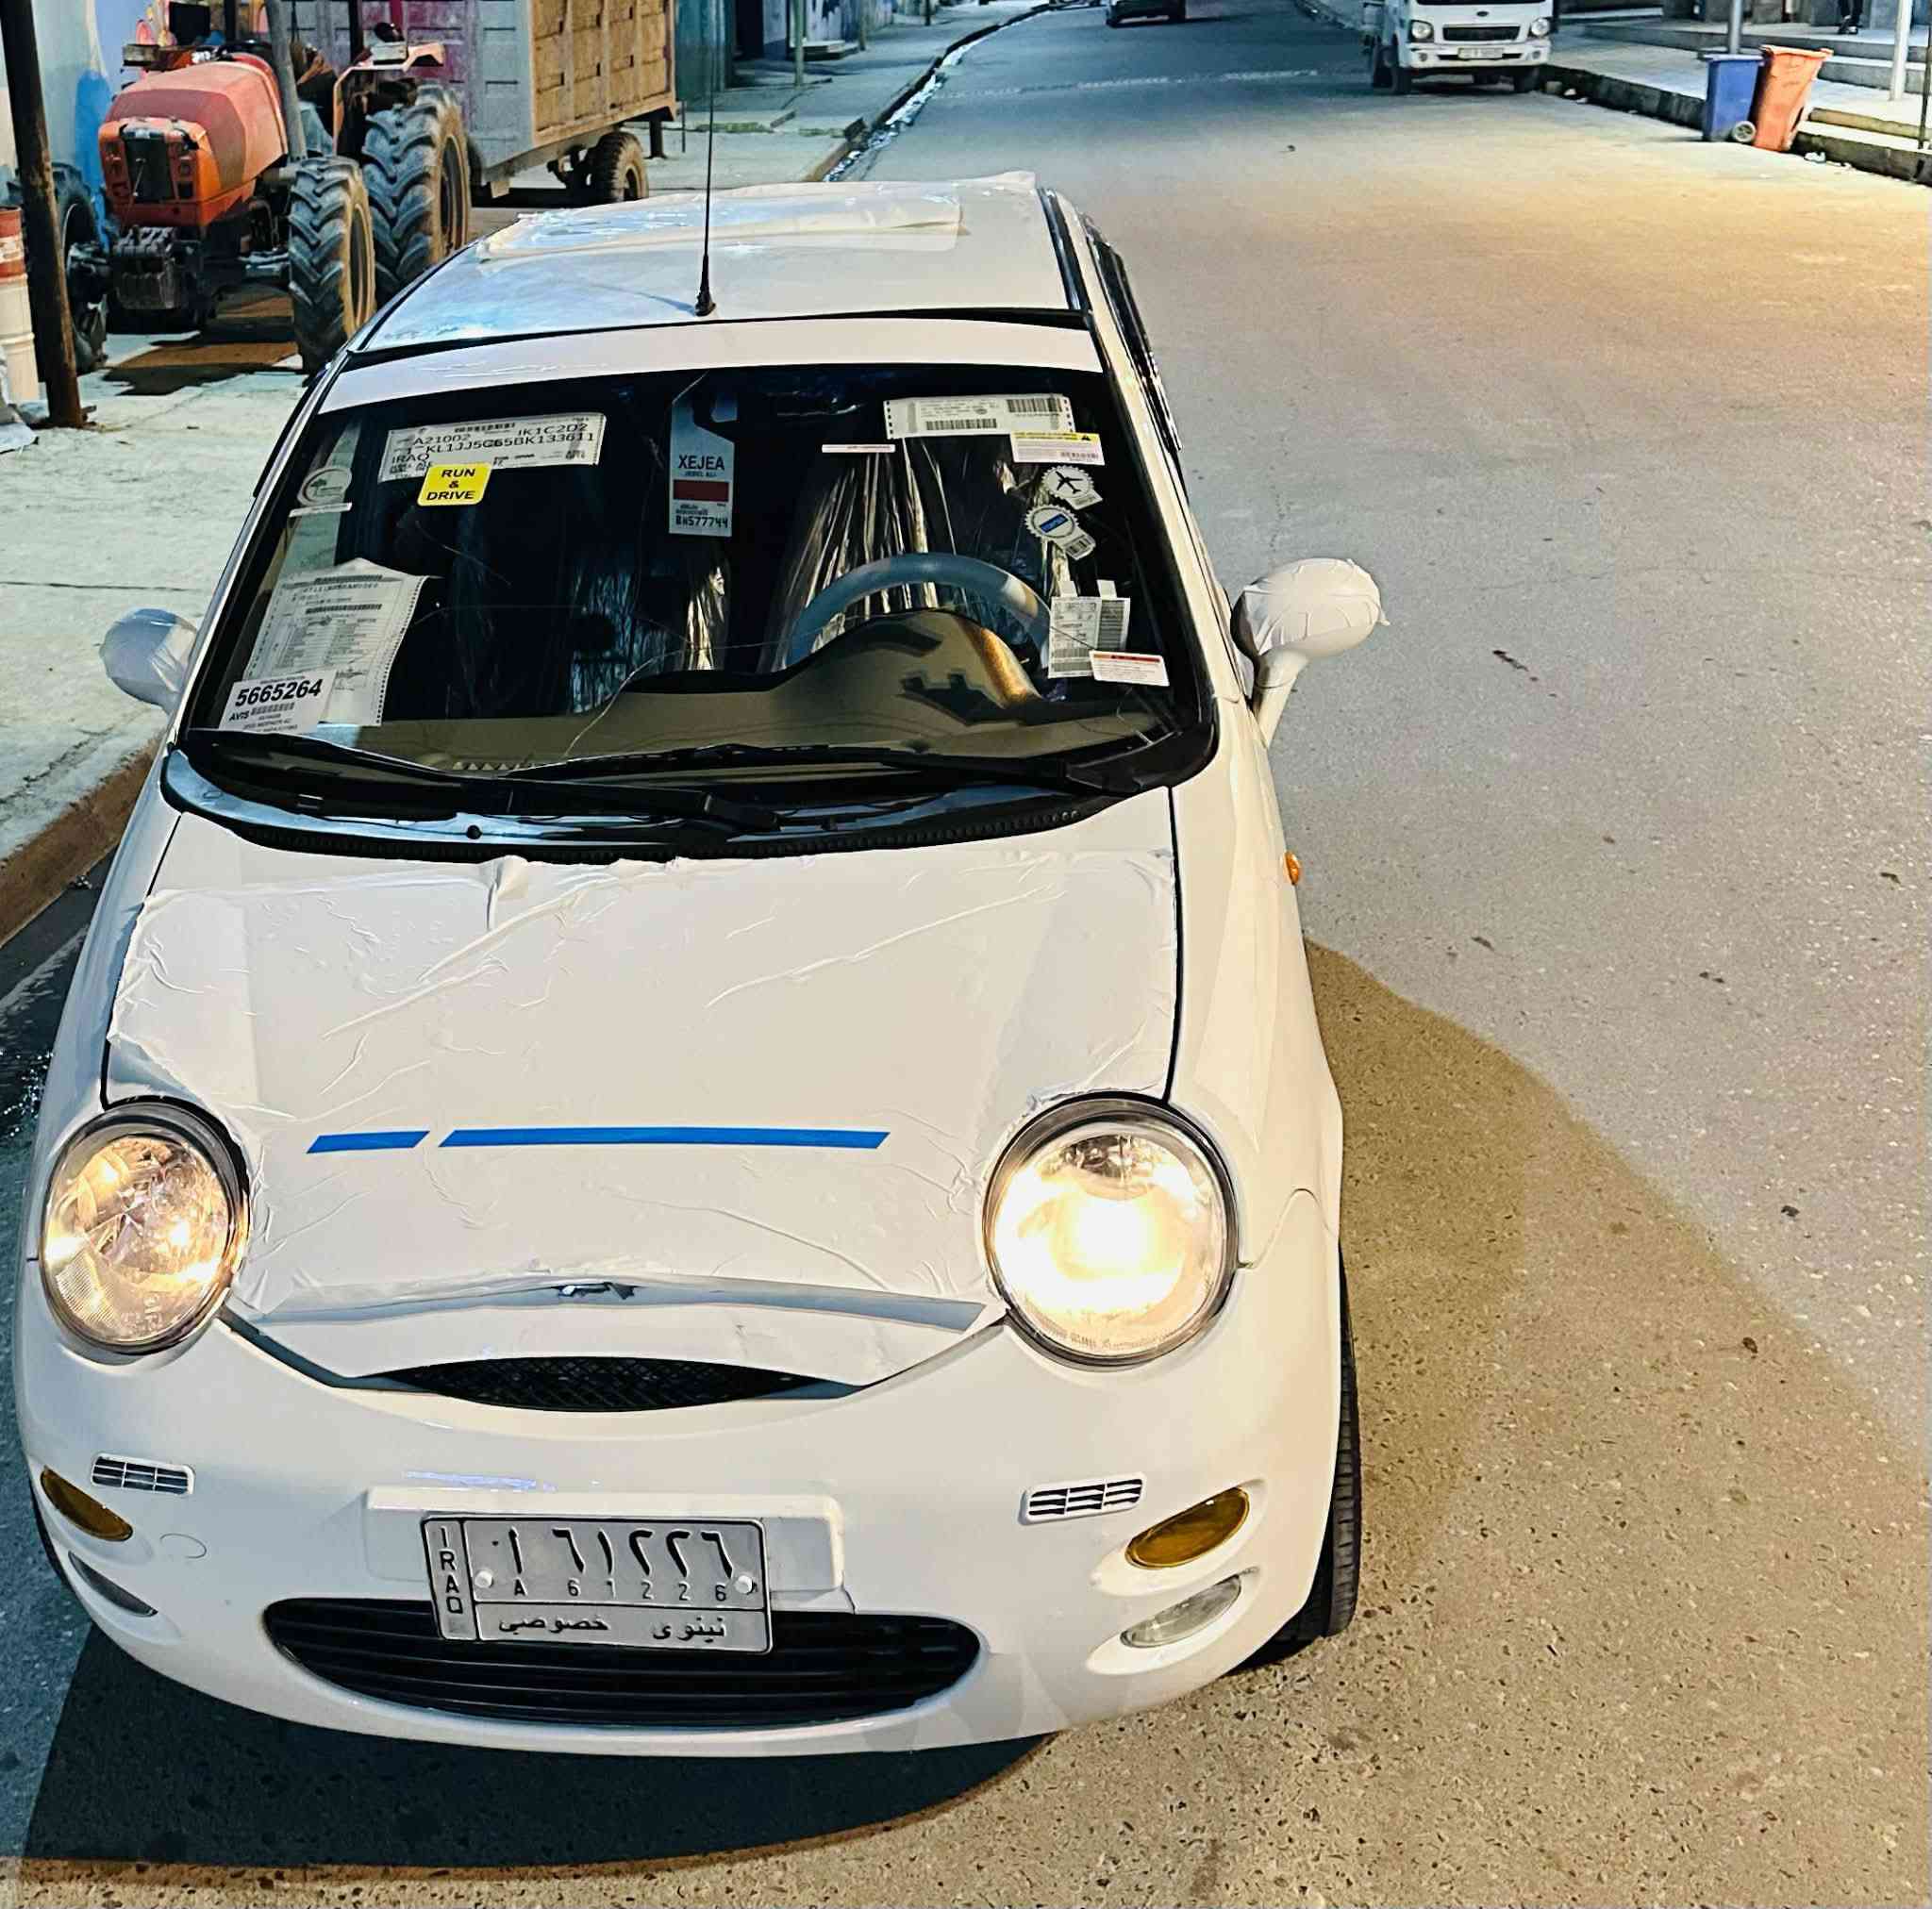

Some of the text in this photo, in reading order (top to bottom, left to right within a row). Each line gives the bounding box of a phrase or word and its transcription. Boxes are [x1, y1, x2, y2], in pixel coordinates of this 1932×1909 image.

[678, 455, 725, 472] XEJEA
[441, 468, 476, 478] RUN
[449, 480, 459, 490] &
[426, 490, 476, 501] DRIVE
[235, 678, 324, 707] 5665264
